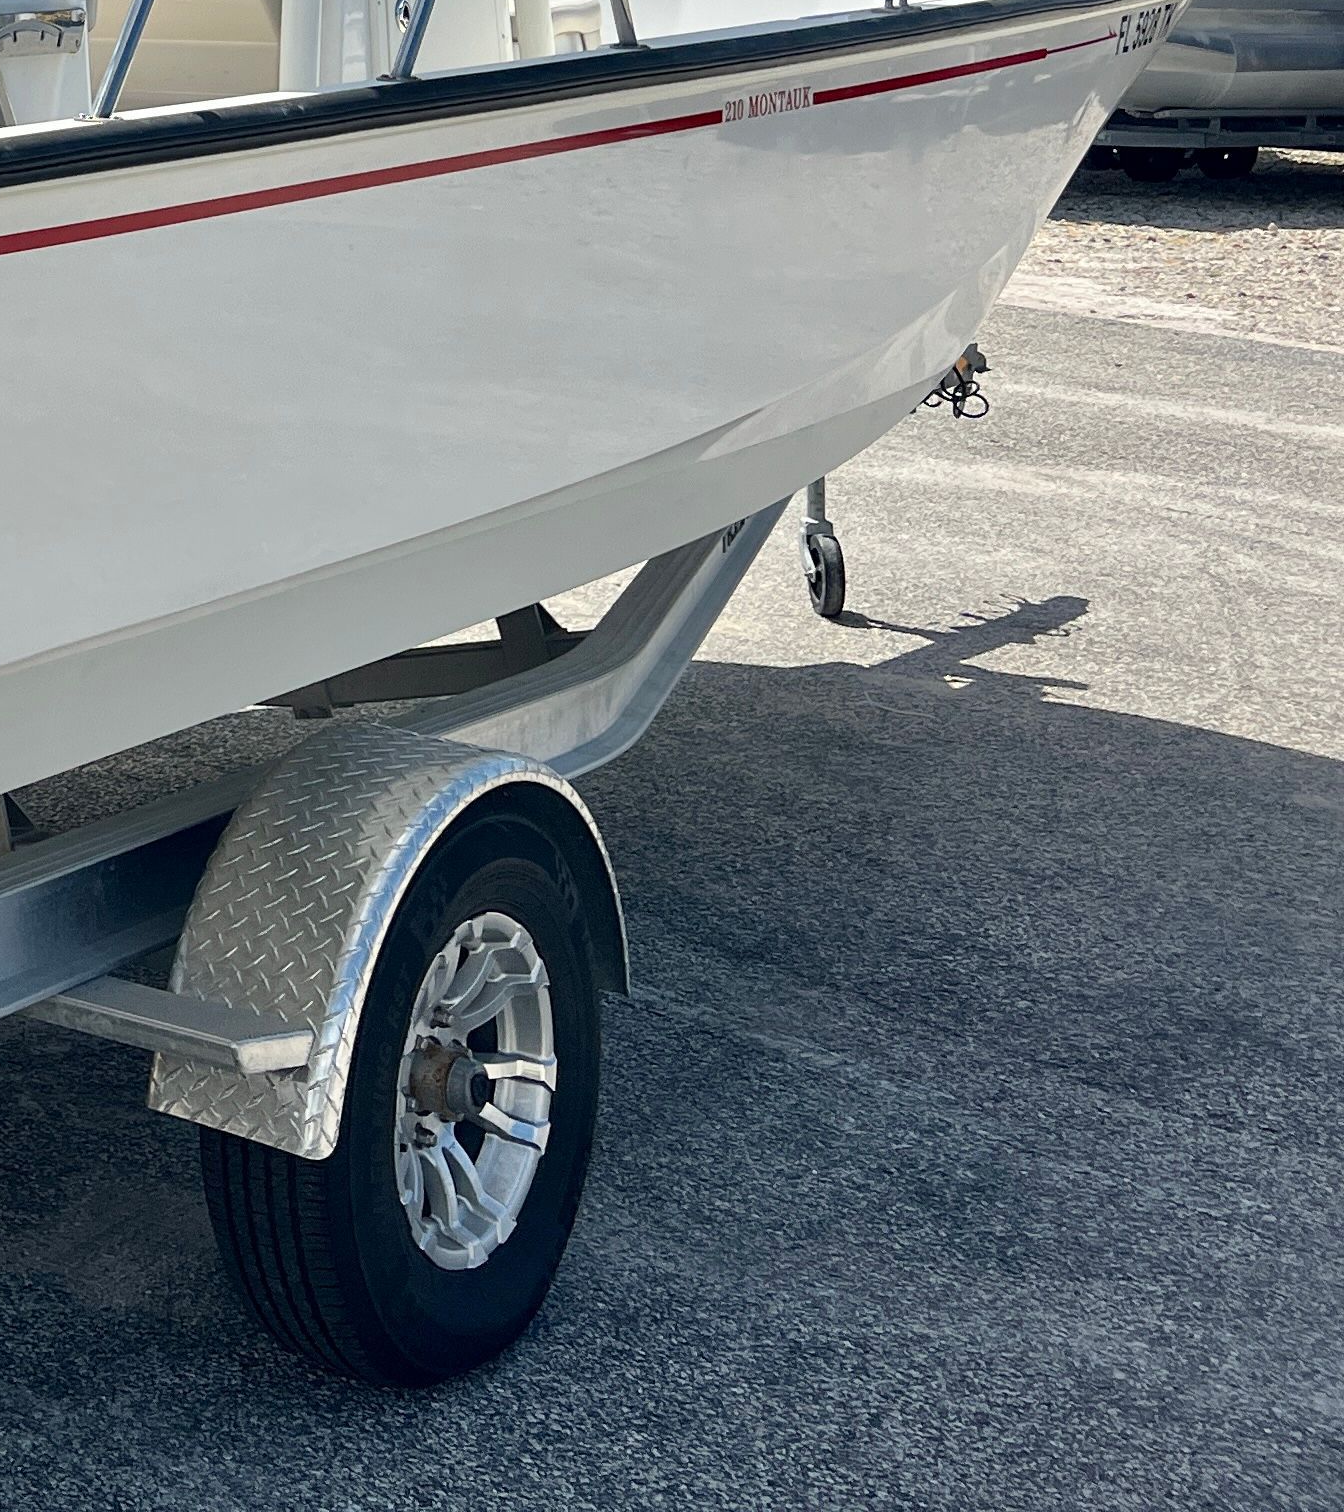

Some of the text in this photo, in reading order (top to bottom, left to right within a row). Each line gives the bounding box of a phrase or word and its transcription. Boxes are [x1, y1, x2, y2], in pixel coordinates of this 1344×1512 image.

[1115, 15, 1132, 55] FL
[725, 86, 811, 122] 210 MONTAUK
